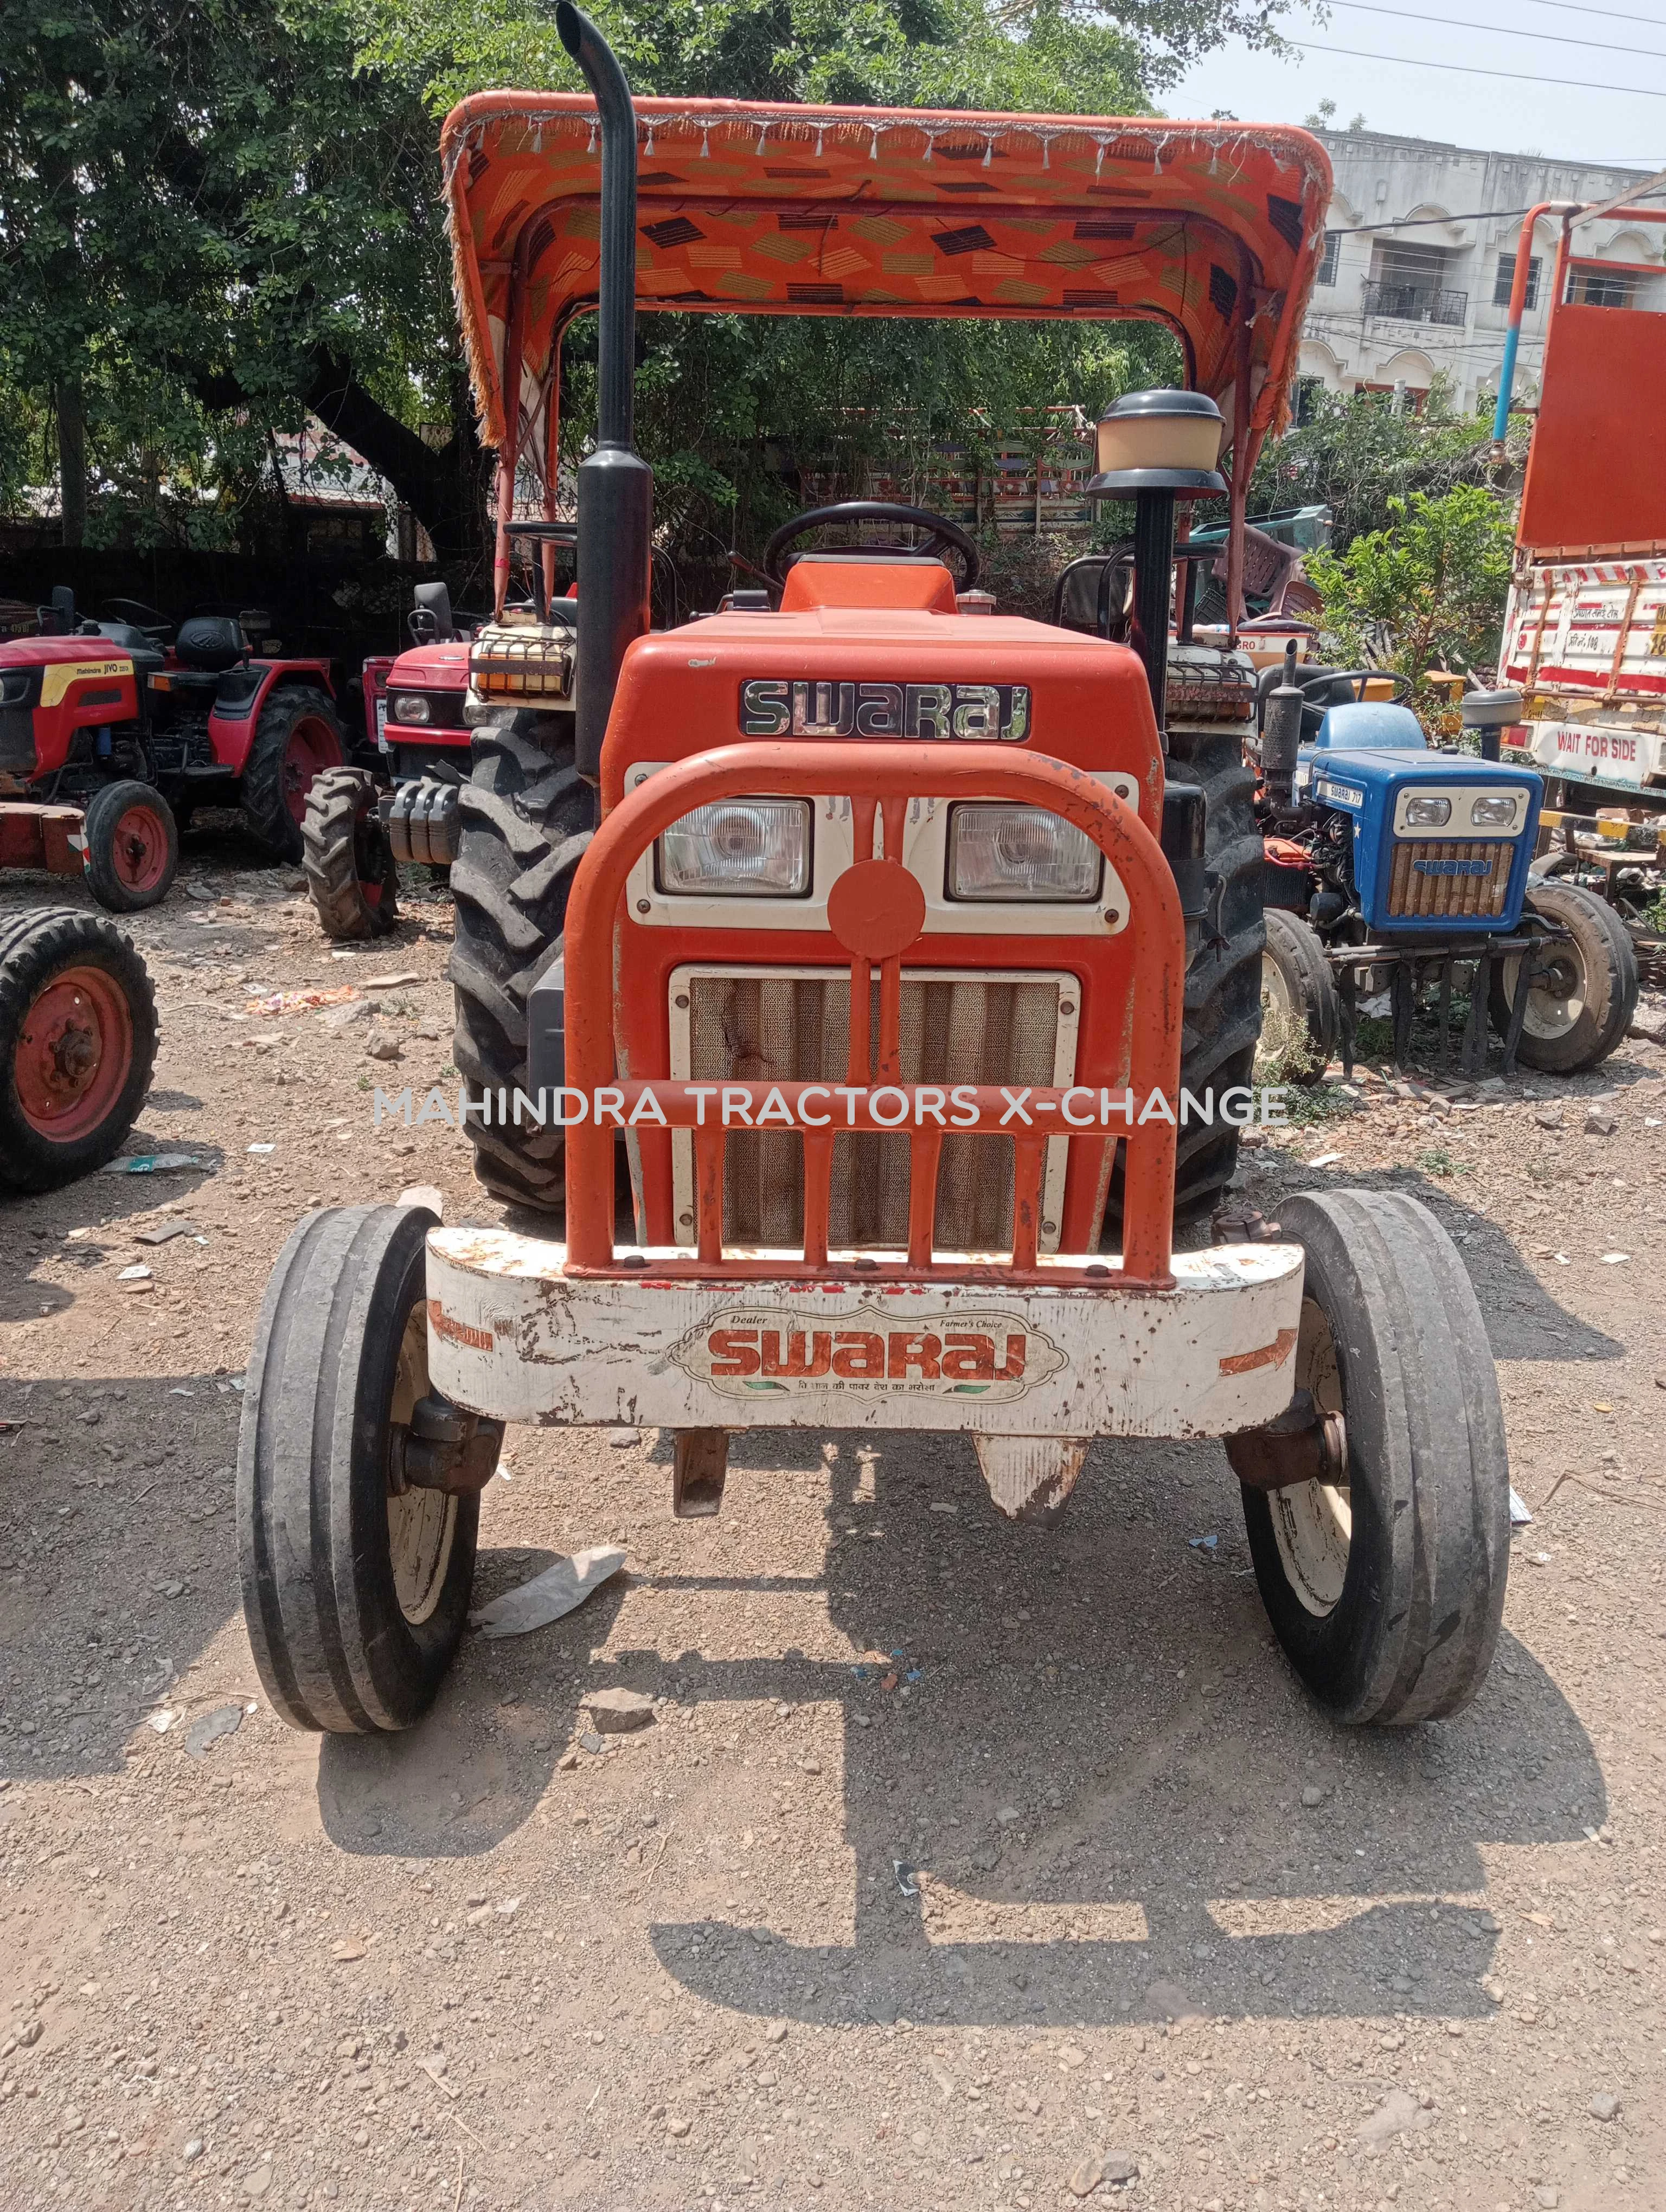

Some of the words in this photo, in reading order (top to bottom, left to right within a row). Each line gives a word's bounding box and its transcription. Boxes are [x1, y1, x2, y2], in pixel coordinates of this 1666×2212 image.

[104, 664, 118, 674] JIVO
[1557, 731, 1581, 754] WAIT
[1585, 735, 1608, 758] FOR
[1611, 738, 1636, 762] SIDE
[1351, 792, 1361, 804] 717
[731, 1315, 768, 1324] Dealer
[940, 1319, 973, 1328] Farmer's
[976, 1320, 1002, 1329] Choice
[832, 1380, 845, 1390] की
